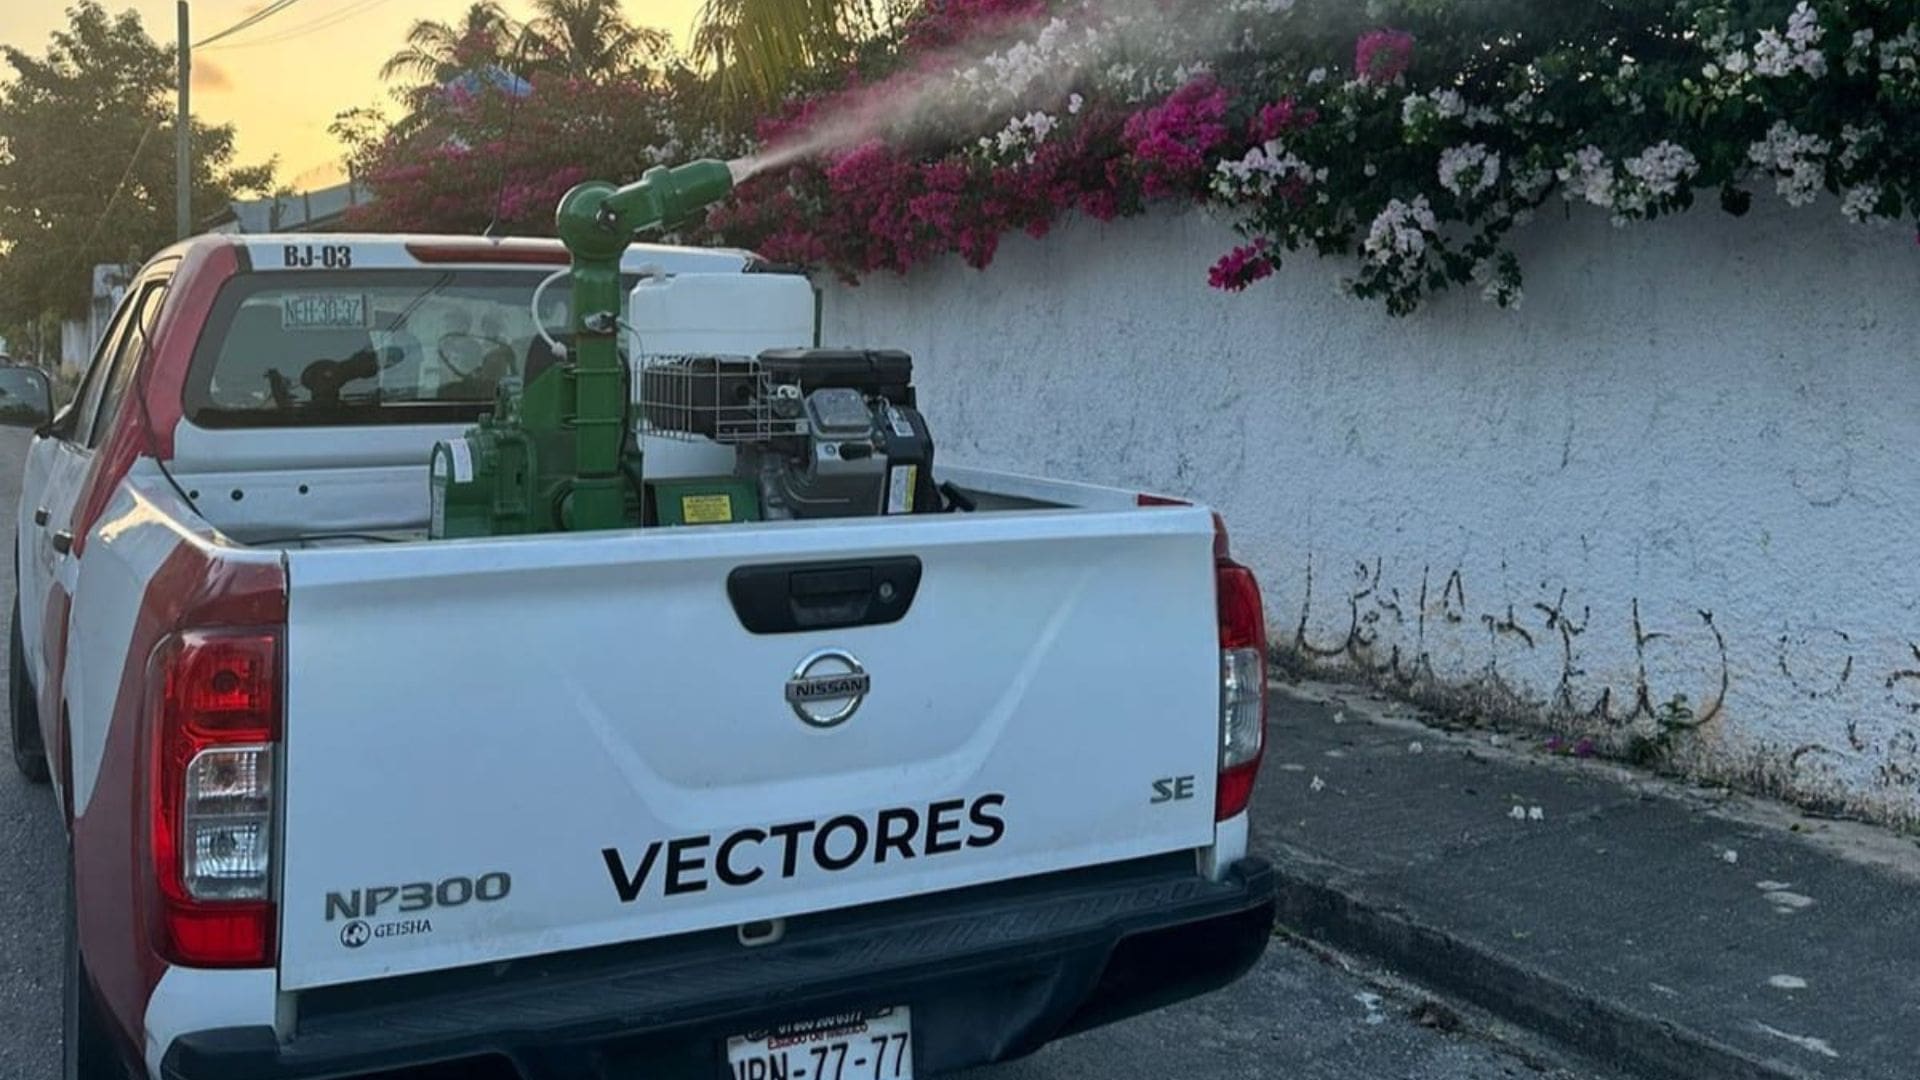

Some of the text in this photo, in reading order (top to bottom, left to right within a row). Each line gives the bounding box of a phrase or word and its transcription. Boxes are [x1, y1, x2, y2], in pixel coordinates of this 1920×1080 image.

[284, 245, 352, 267] BJ-03
[796, 679, 862, 696] NISSAN
[1150, 775, 1195, 804] SE
[602, 793, 1005, 903] VECTORES
[325, 872, 511, 921] NP300
[374, 919, 432, 938] GEISHA
